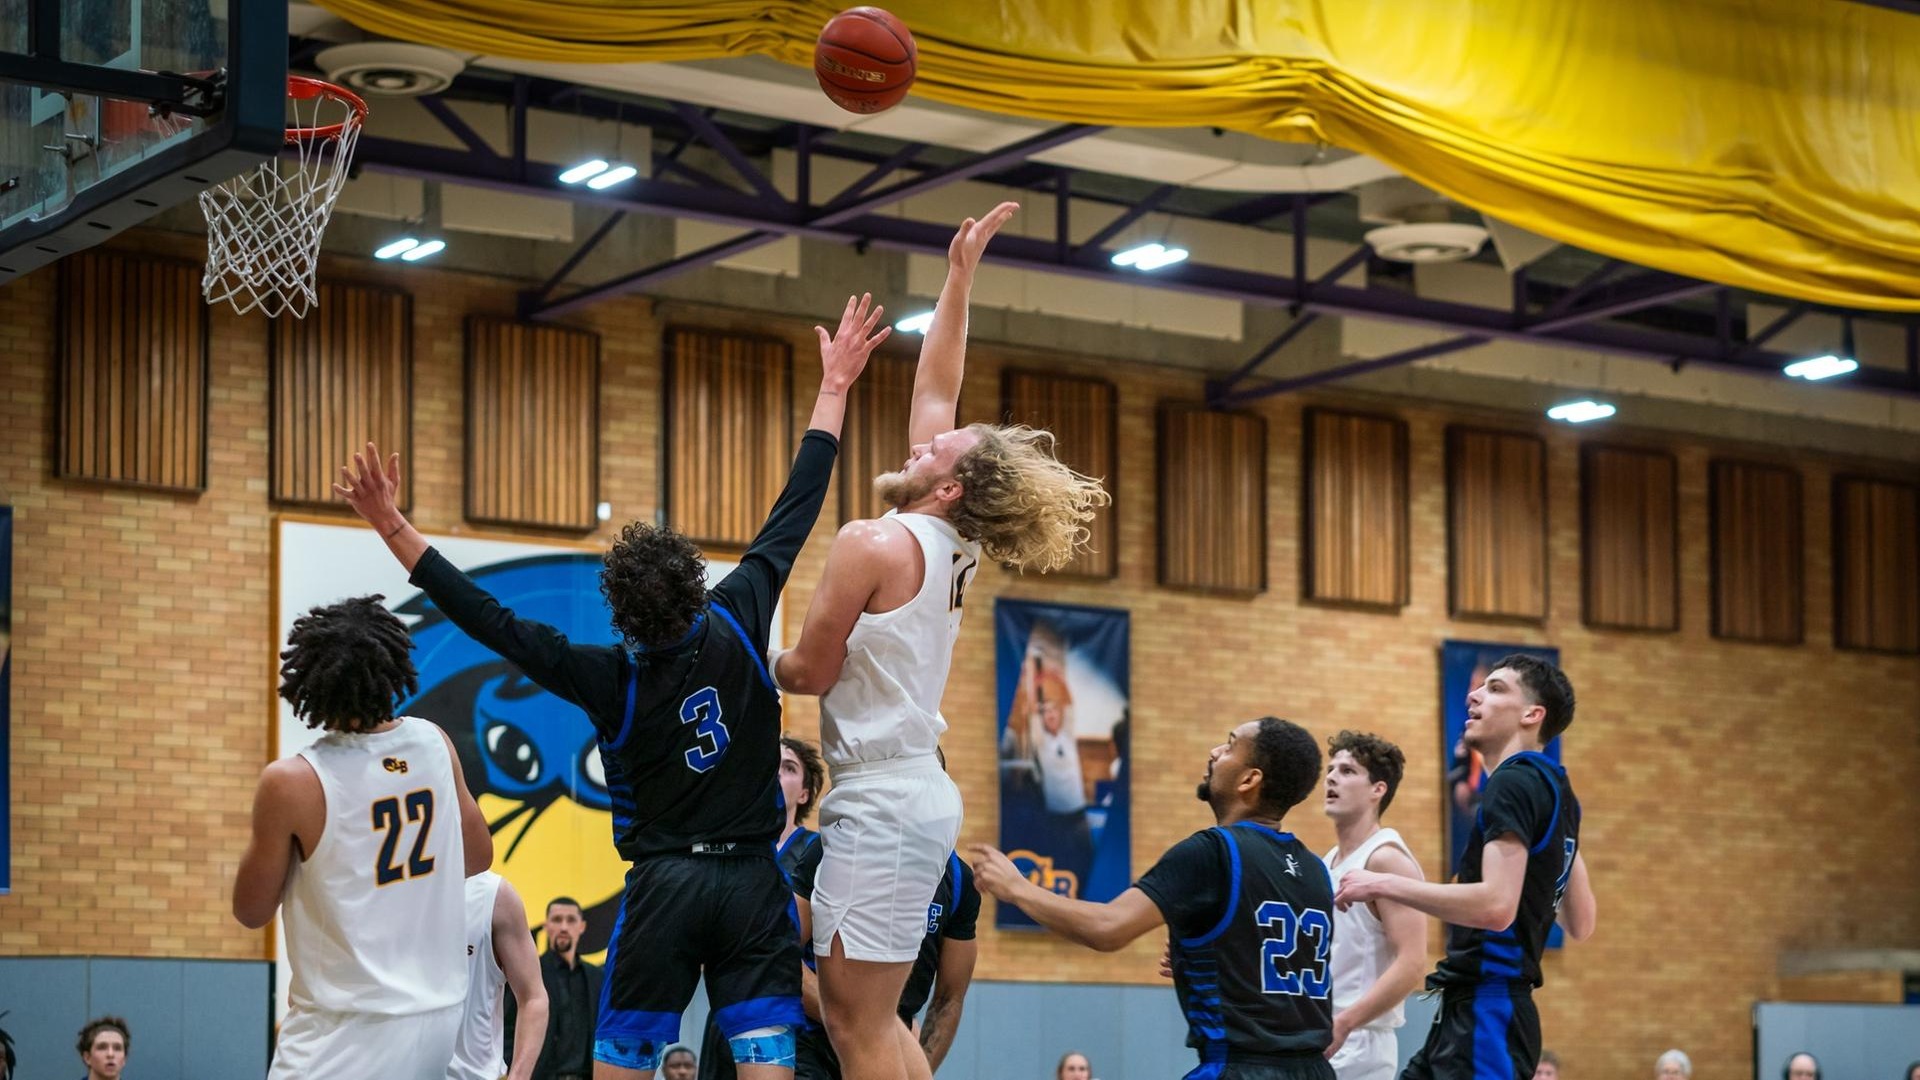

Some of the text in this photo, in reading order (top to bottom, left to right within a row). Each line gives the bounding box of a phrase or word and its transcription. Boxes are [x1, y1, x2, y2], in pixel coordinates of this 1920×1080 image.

[679, 685, 732, 774] 3
[371, 786, 436, 888] 22
[1254, 900, 1333, 1000] 23
